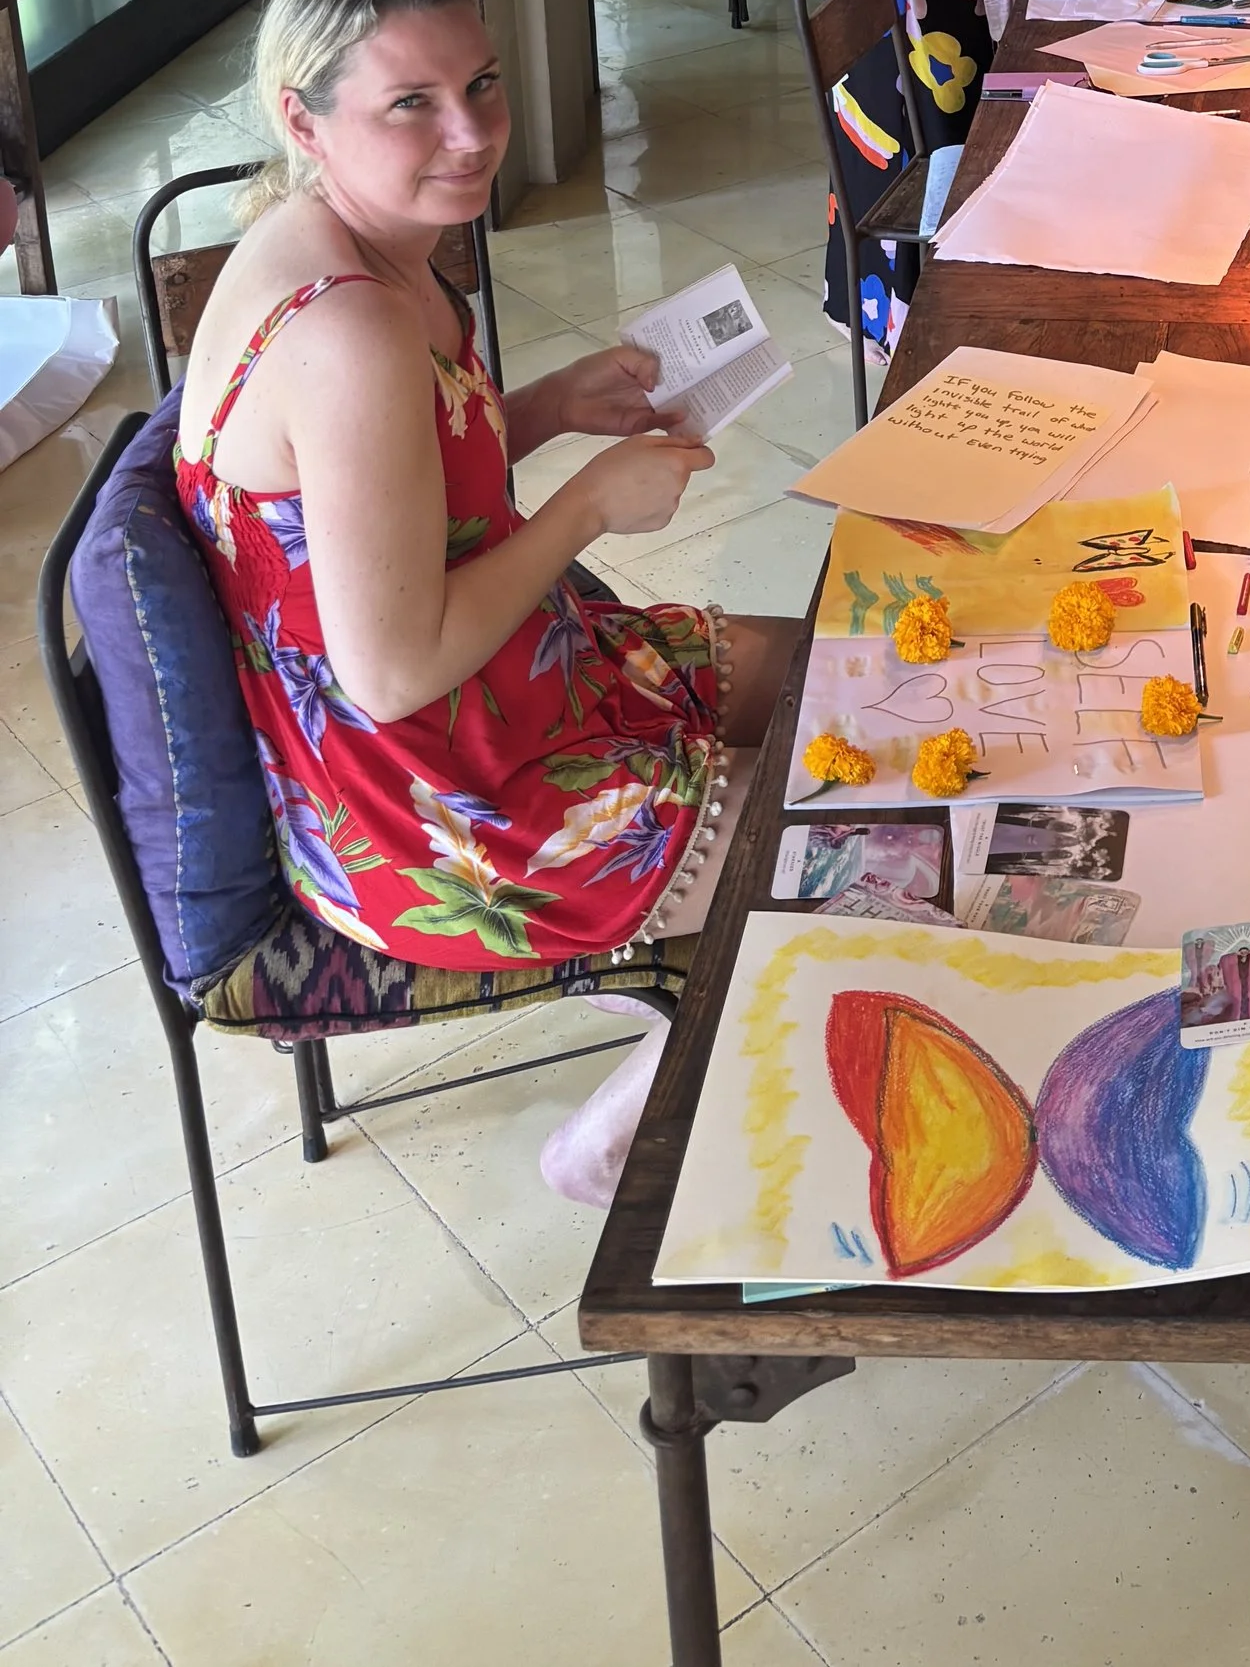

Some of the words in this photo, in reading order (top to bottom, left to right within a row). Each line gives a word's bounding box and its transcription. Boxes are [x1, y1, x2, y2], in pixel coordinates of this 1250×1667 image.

[971, 383, 998, 398] you
[1069, 404, 1097, 419] the
[1002, 403, 1041, 419] trail
[1071, 422, 1097, 433] what
[887, 415, 960, 440] without
[1009, 447, 1048, 466] trying
[905, 404, 949, 420] light
[957, 420, 978, 433] up
[984, 427, 1014, 441] the
[1021, 437, 1065, 452] world
[964, 409, 989, 420] you
[1019, 424, 1041, 435] you
[1048, 430, 1077, 442] will
[976, 639, 1049, 757] LOVE
[1072, 638, 1167, 769] SELF
